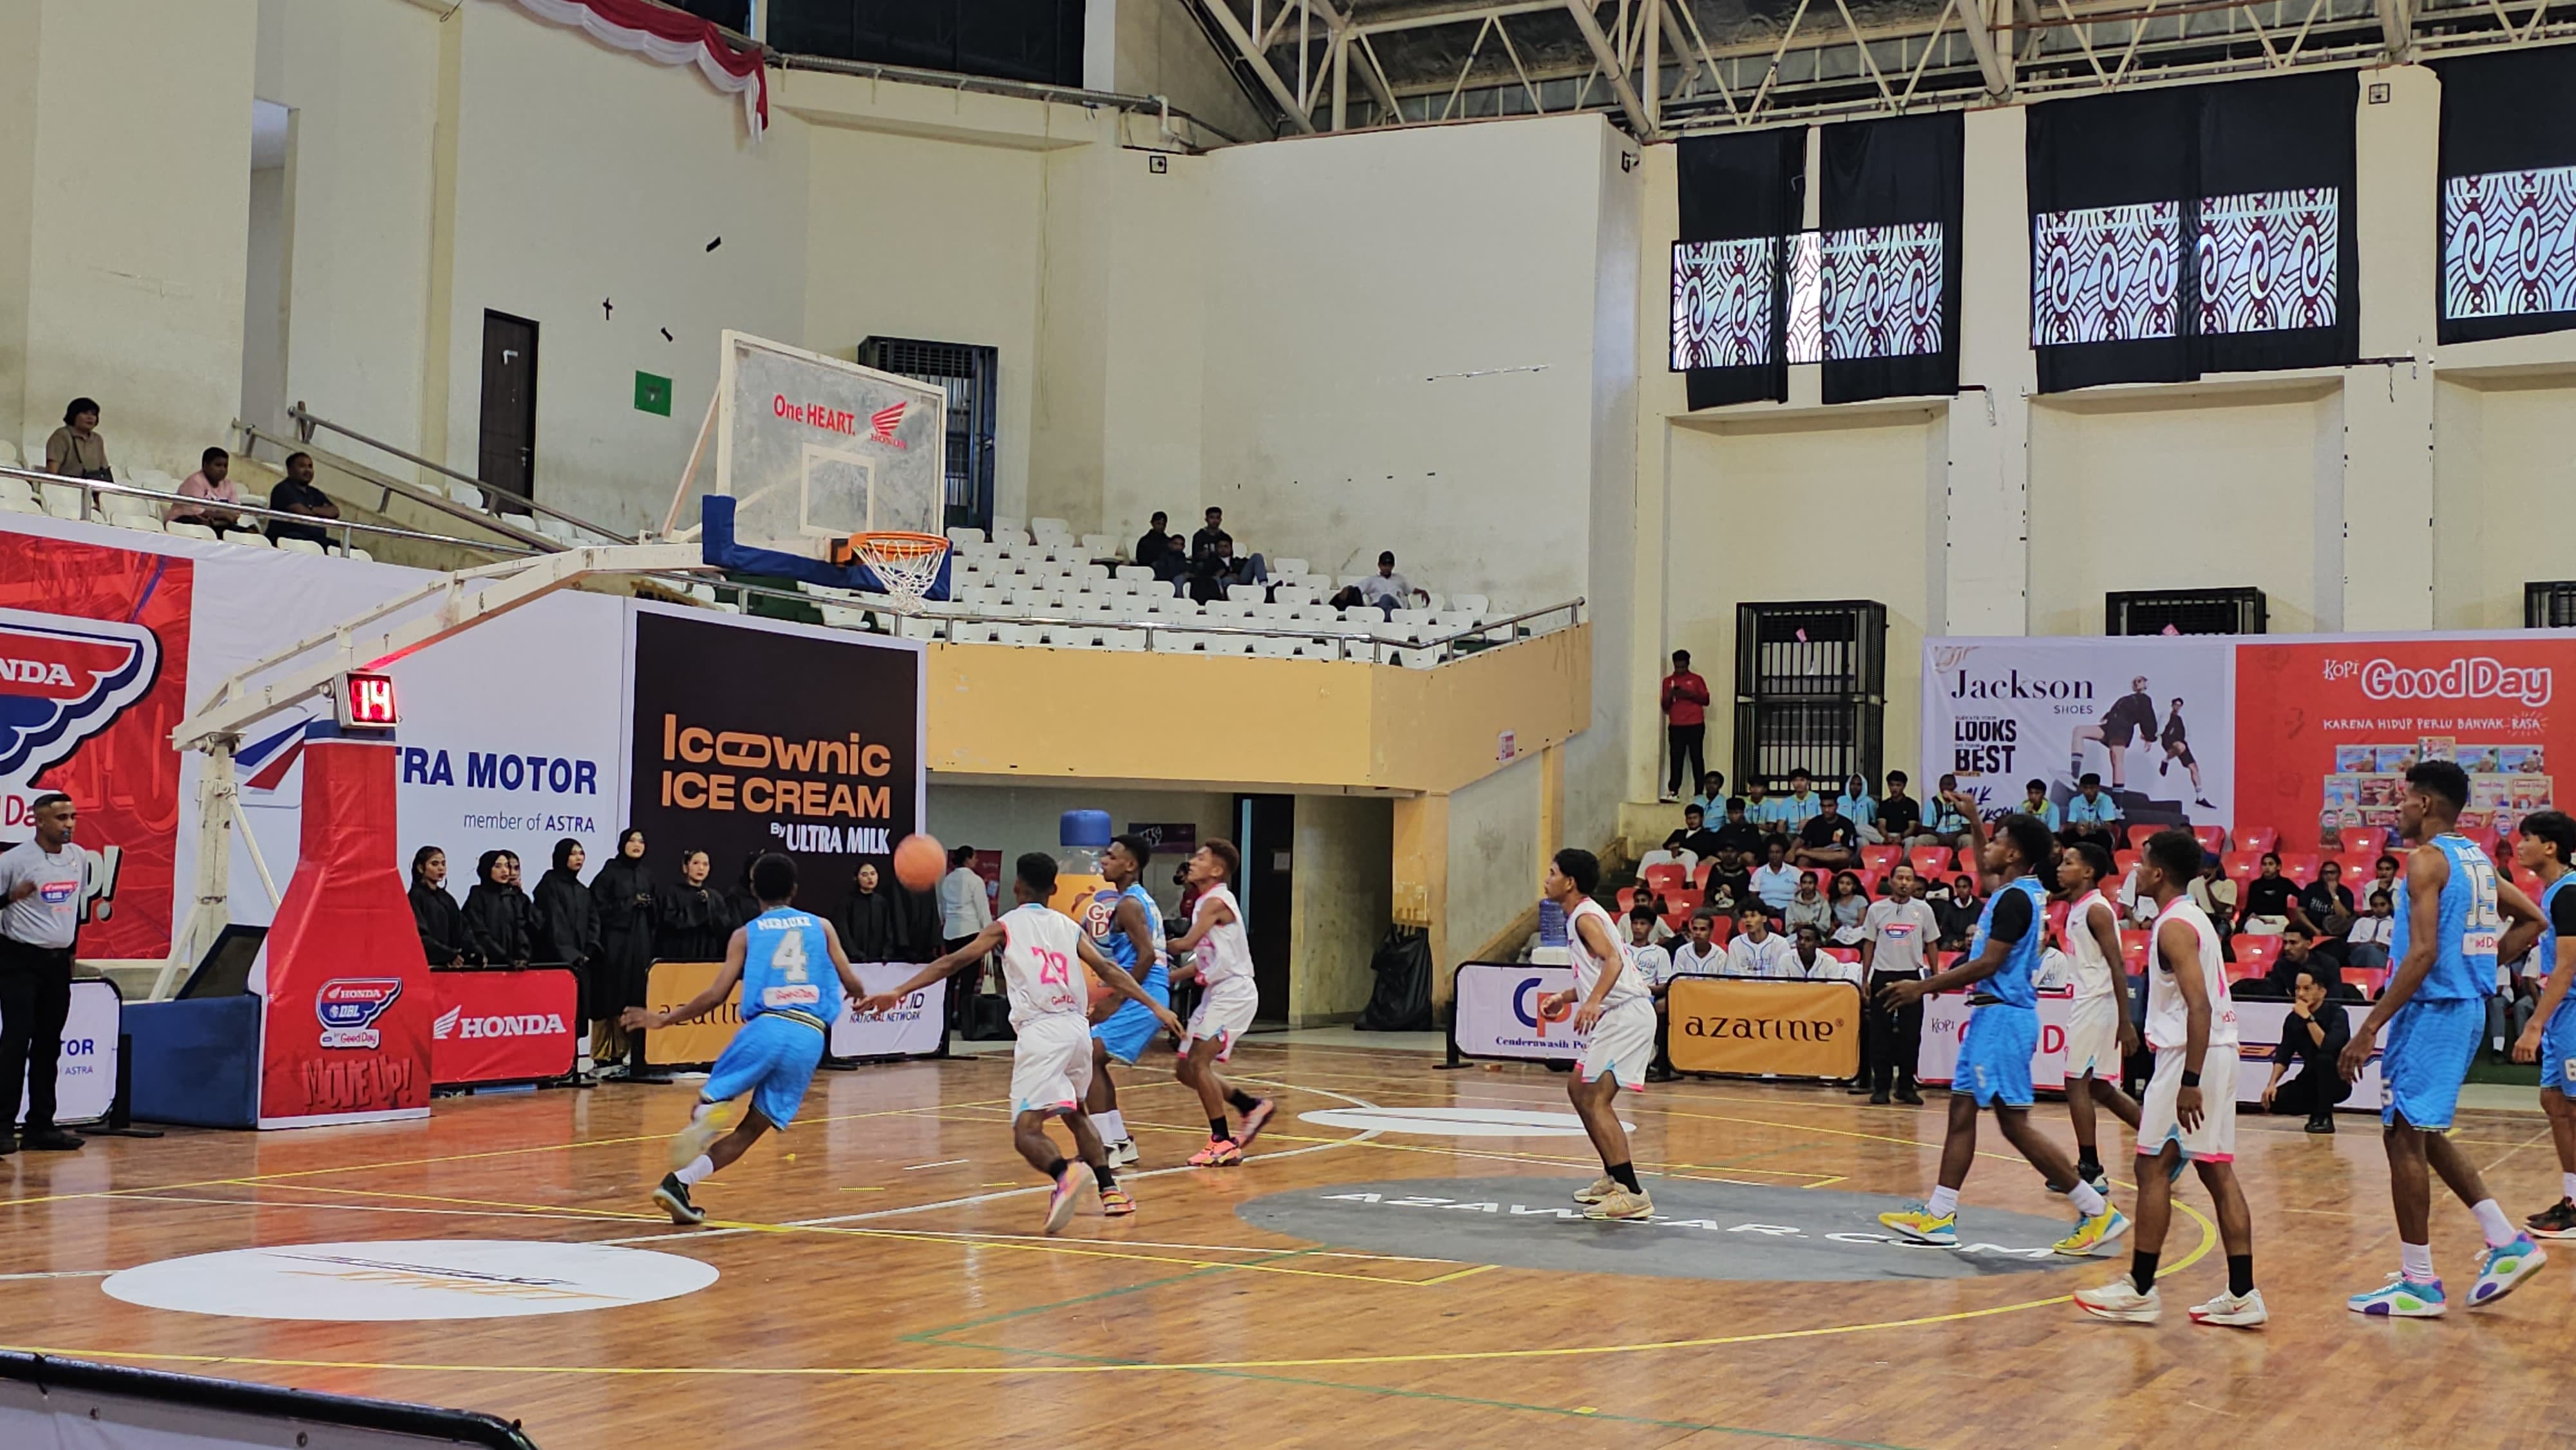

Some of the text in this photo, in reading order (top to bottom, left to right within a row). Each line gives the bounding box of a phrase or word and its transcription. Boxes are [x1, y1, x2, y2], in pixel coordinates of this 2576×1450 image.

[774, 394, 803, 422] One
[1951, 669, 2094, 699] Jackson
[361, 680, 392, 719] 14
[2053, 706, 2094, 715] SHOES
[1955, 719, 2017, 742] LOOKS
[2323, 717, 2541, 731] KARENA HIDUP PERLU BANYAK RASA
[1955, 745, 2016, 773] BEST
[467, 752, 597, 795] MOTOR
[662, 771, 891, 819] ICE CREAM
[464, 811, 596, 833] member of ASTRA
[771, 822, 891, 854] By ULTRA MILK
[772, 928, 808, 982] 4
[1032, 946, 1069, 986] 29
[341, 989, 382, 999] HONDA
[459, 1013, 567, 1039] HONDA
[886, 1010, 920, 1022] NETWORK
[1495, 1036, 1569, 1048] Cenderawasih
[65, 1065, 94, 1075] ASTRA
